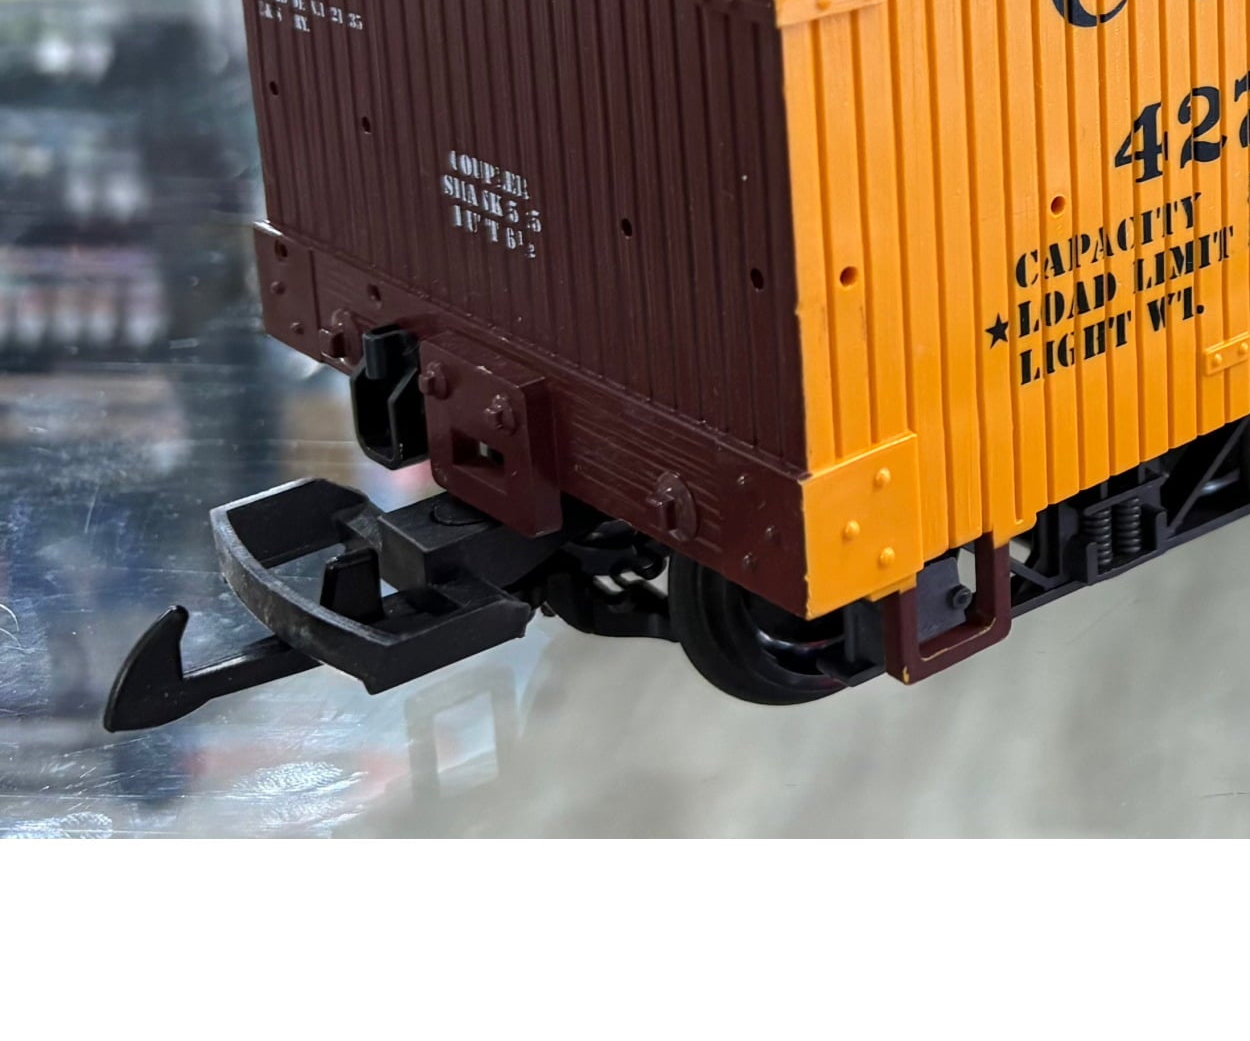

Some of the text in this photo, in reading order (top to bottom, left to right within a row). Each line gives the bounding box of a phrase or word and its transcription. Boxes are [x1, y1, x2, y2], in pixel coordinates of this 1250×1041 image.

[1016, 192, 1202, 288] CAPACITY
[1018, 272, 1116, 338] LOAD
[1133, 226, 1234, 294] LIMIT
[1020, 311, 1131, 385] LIGHT
